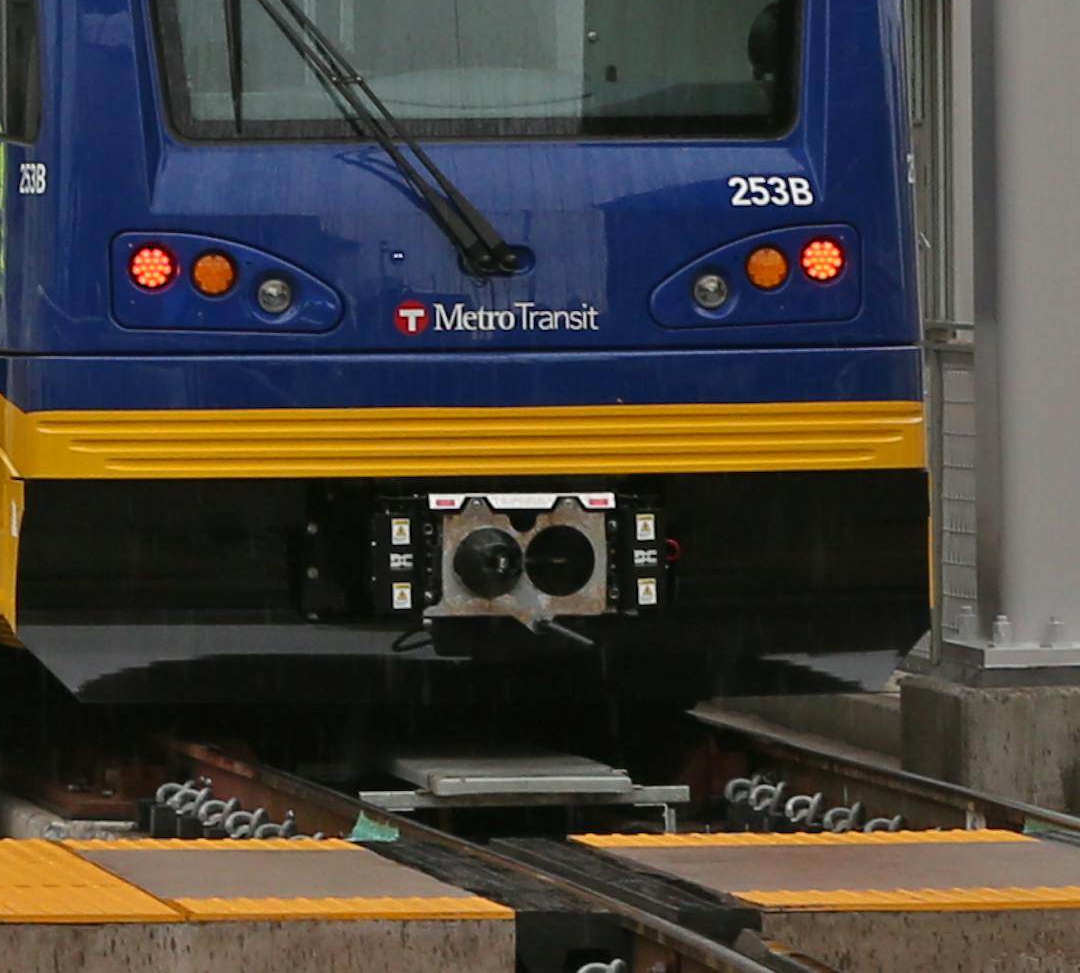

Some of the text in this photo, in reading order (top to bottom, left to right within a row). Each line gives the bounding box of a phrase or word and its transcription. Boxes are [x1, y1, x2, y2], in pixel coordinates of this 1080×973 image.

[19, 162, 47, 195] 253B
[727, 175, 815, 207] 253B
[432, 302, 516, 332] Metro
[514, 301, 600, 331] Transit
